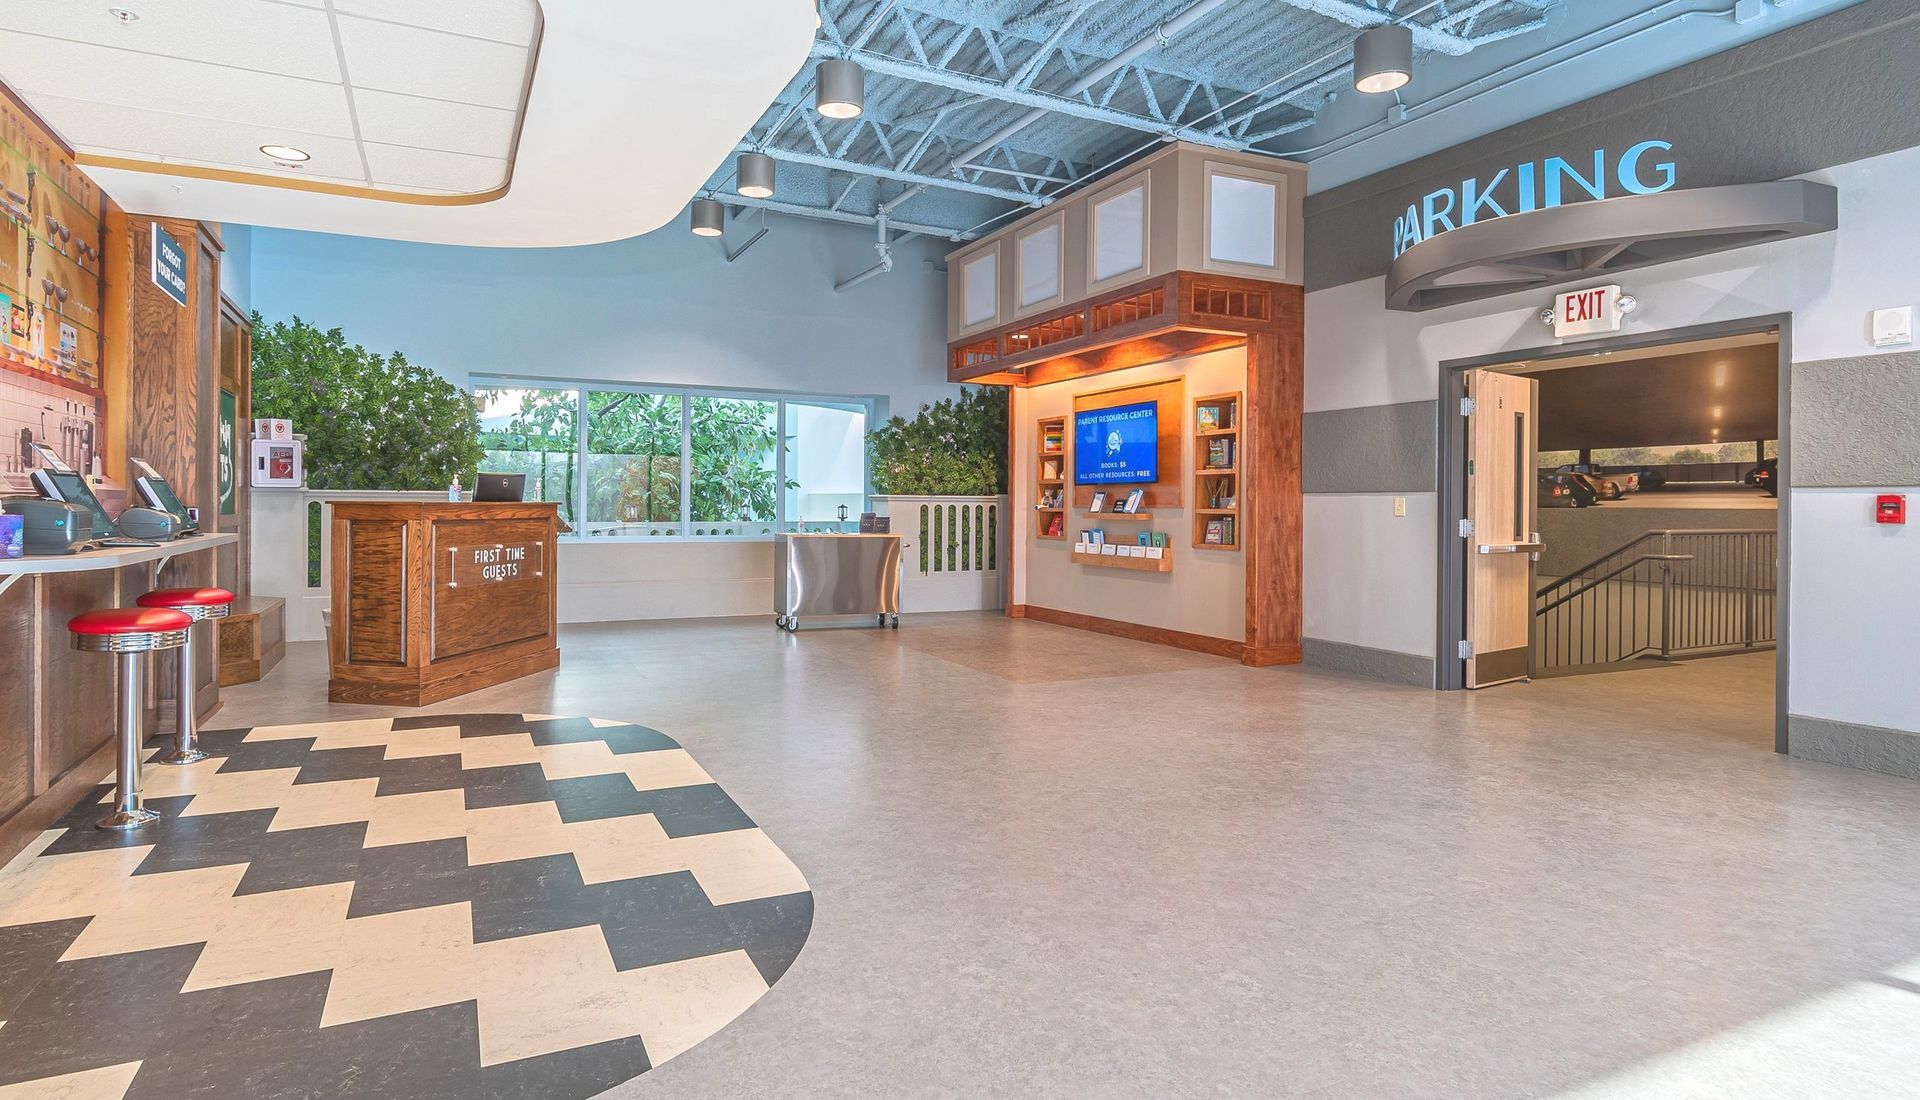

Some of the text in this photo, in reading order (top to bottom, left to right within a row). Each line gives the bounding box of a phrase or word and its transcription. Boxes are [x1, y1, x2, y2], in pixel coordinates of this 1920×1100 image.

[1392, 139, 1677, 261] PARKING
[162, 242, 181, 271] FORGOT
[157, 258, 171, 282] YOUR
[1565, 289, 1605, 323] EXIT
[1077, 409, 1153, 426] PARENT RESOURCE CENTER
[475, 547, 524, 563] FIRST TIME
[483, 563, 517, 579] GUESTS
